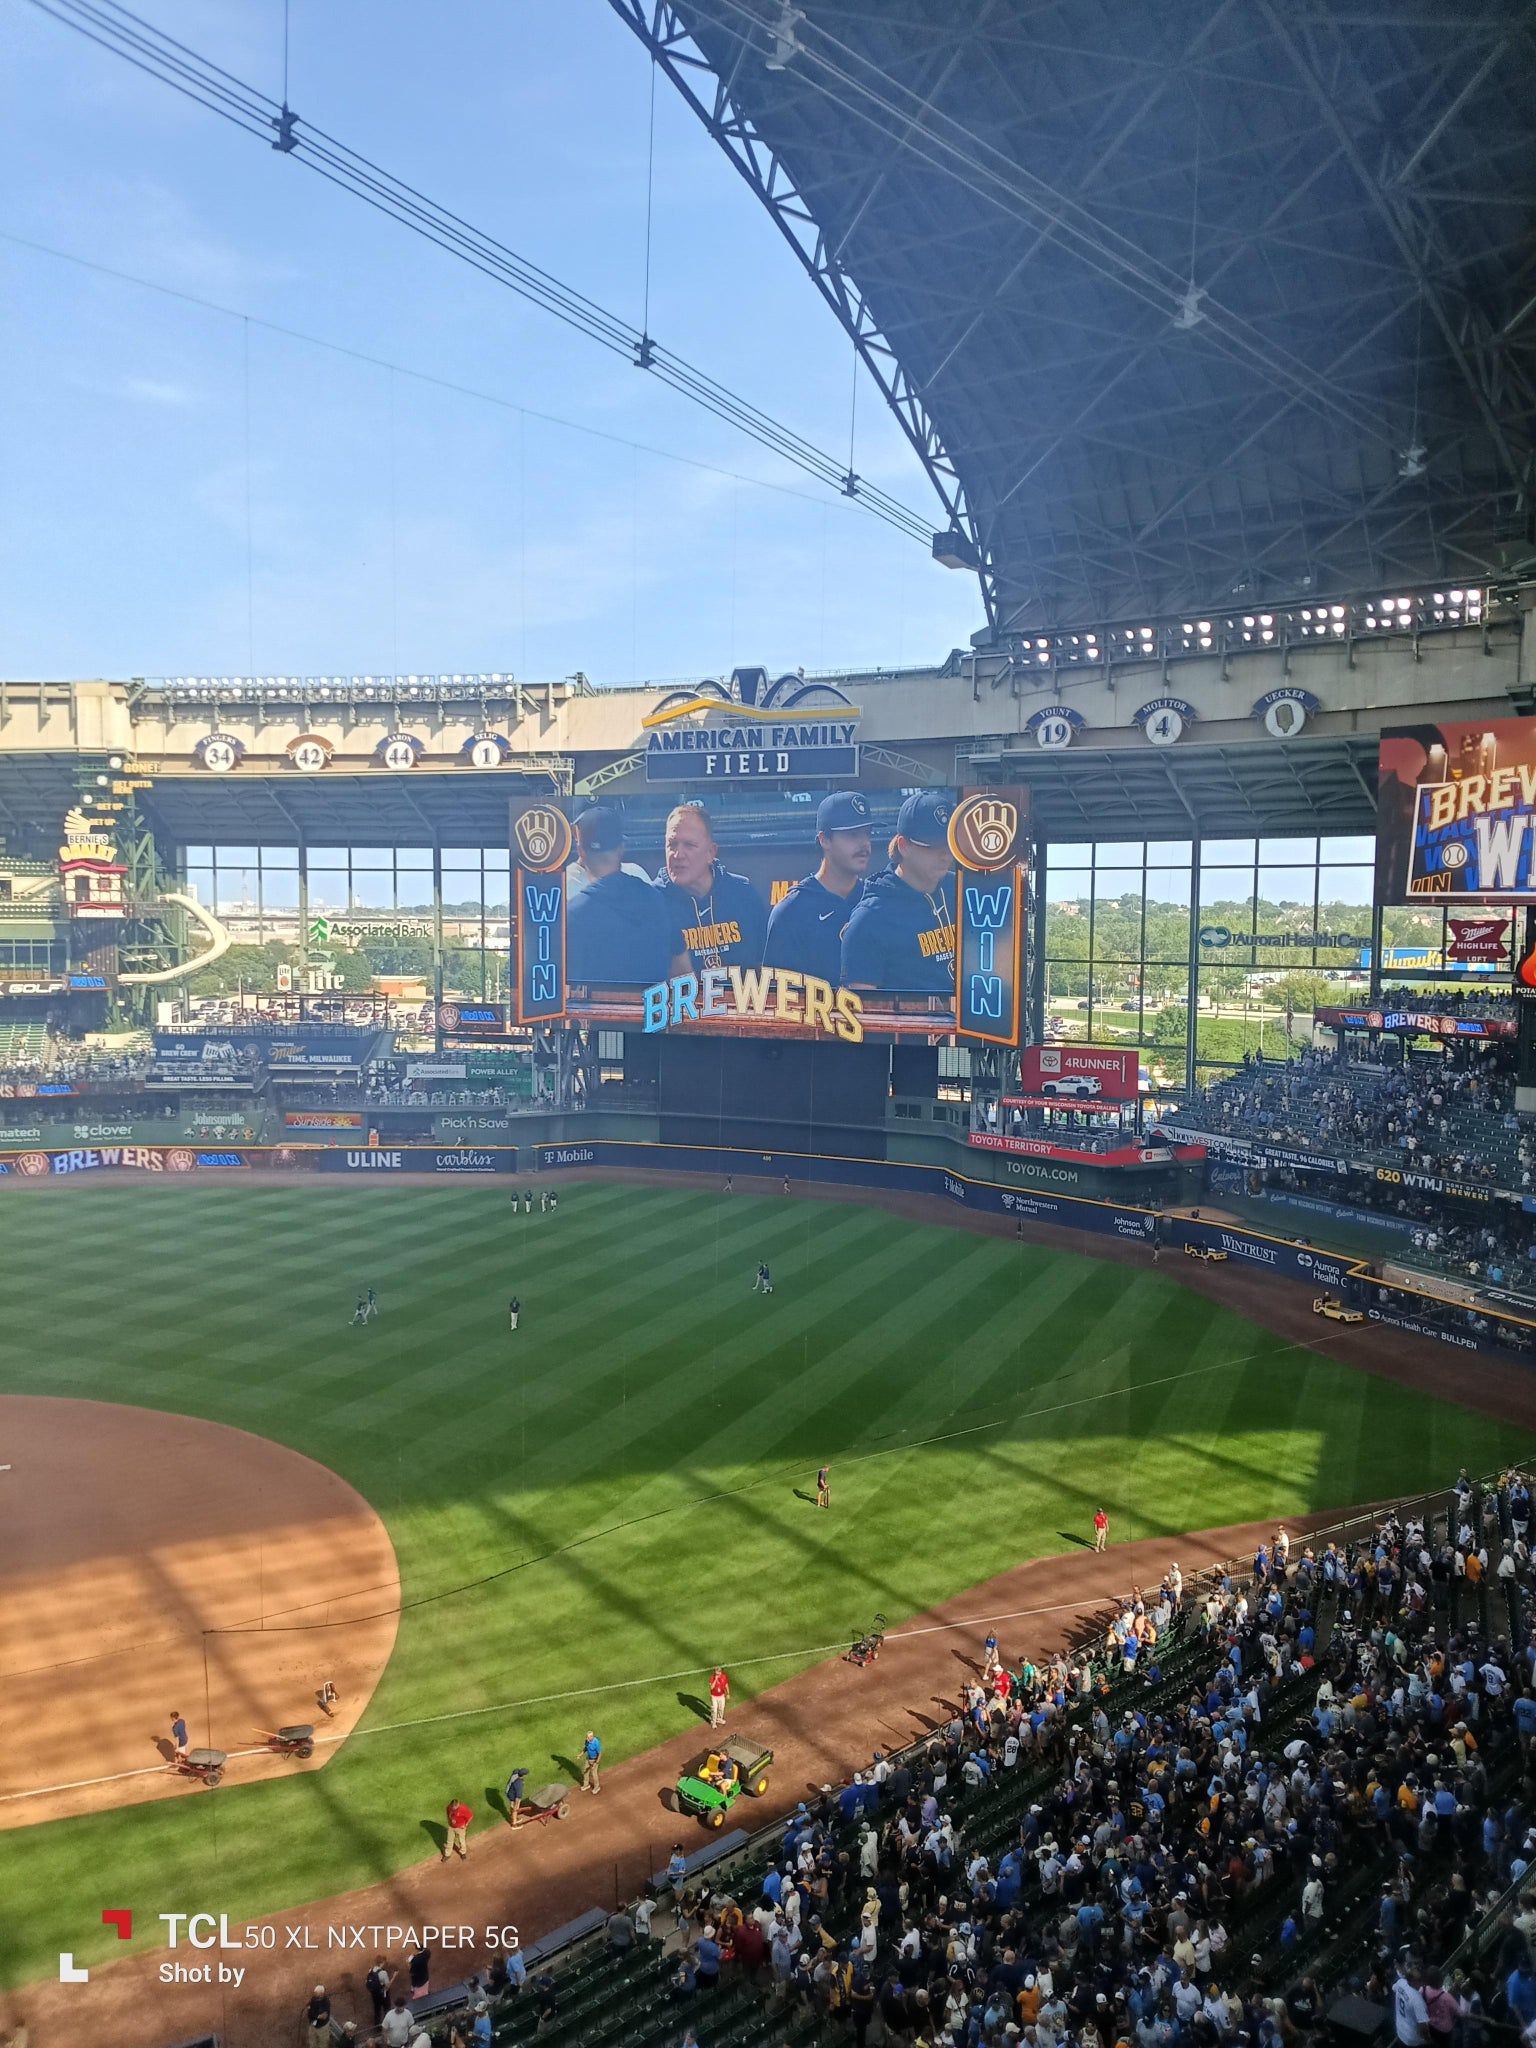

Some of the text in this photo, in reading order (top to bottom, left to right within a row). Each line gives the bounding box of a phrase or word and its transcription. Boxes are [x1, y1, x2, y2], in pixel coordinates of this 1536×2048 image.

[1264, 689, 1305, 703] UECKER
[1039, 708, 1072, 718] YOUNT
[1142, 700, 1188, 715] MOLITOR
[1155, 716, 1170, 737] 4
[203, 734, 236, 745] FINGERS
[387, 734, 412, 744] AARON
[474, 733, 497, 741] SELIG
[648, 724, 856, 751] AMERICAN FAMILY
[1042, 724, 1067, 745] 19
[209, 748, 231, 764] 34
[299, 748, 320, 764] 42
[389, 748, 411, 764] 44
[482, 748, 491, 764] 1
[706, 753, 789, 774] FIELD
[330, 923, 431, 937] Associated Bank
[1461, 926, 1495, 941] Miller
[526, 886, 561, 1001] WIN
[1234, 931, 1372, 948] Aurora Health Care
[966, 886, 1011, 1018] WIN
[9, 983, 63, 993] GOLF
[642, 966, 864, 1043] BREWERS
[1384, 1012, 1440, 1033] BREWERS
[268, 1045, 306, 1061] Miller
[288, 1055, 352, 1063] TIME, MILWAUKEE
[1065, 1058, 1120, 1071] 4RUNNER
[1003, 1097, 1027, 1105] COURTESY
[1048, 1101, 1077, 1109] WISCONSIN
[193, 1113, 245, 1126] Johnsonville
[293, 1115, 332, 1127] Surfside
[478, 1117, 509, 1129] Save
[89, 1124, 133, 1136] clover
[971, 1135, 1053, 1154] TOYOTA TERRITORY
[347, 1151, 401, 1167] ULINE
[436, 1150, 495, 1166] carbliss
[557, 1149, 594, 1163] Mobile
[1264, 1148, 1281, 1157] GREAT
[54, 1148, 163, 1174] BREWERS
[1006, 1161, 1078, 1183] TOYOTA.COM
[1376, 1168, 1443, 1192] 620 WTMJ
[949, 1178, 965, 1199] Mobile
[1445, 1187, 1489, 1201] BREWERS
[1015, 1196, 1058, 1211] Northwestern
[1015, 1203, 1038, 1214] Mutual
[1113, 1216, 1140, 1228] Johnson
[1118, 1225, 1146, 1237] Controls
[1221, 1233, 1277, 1261] WINTRUST
[1313, 1260, 1340, 1275] Aurora
[1313, 1269, 1339, 1285] Health
[1504, 1297, 1534, 1308] Aurora
[1381, 1313, 1478, 1350] Aurora Health Care BULLPEN
[1006, 1745, 1017, 1754] 28
